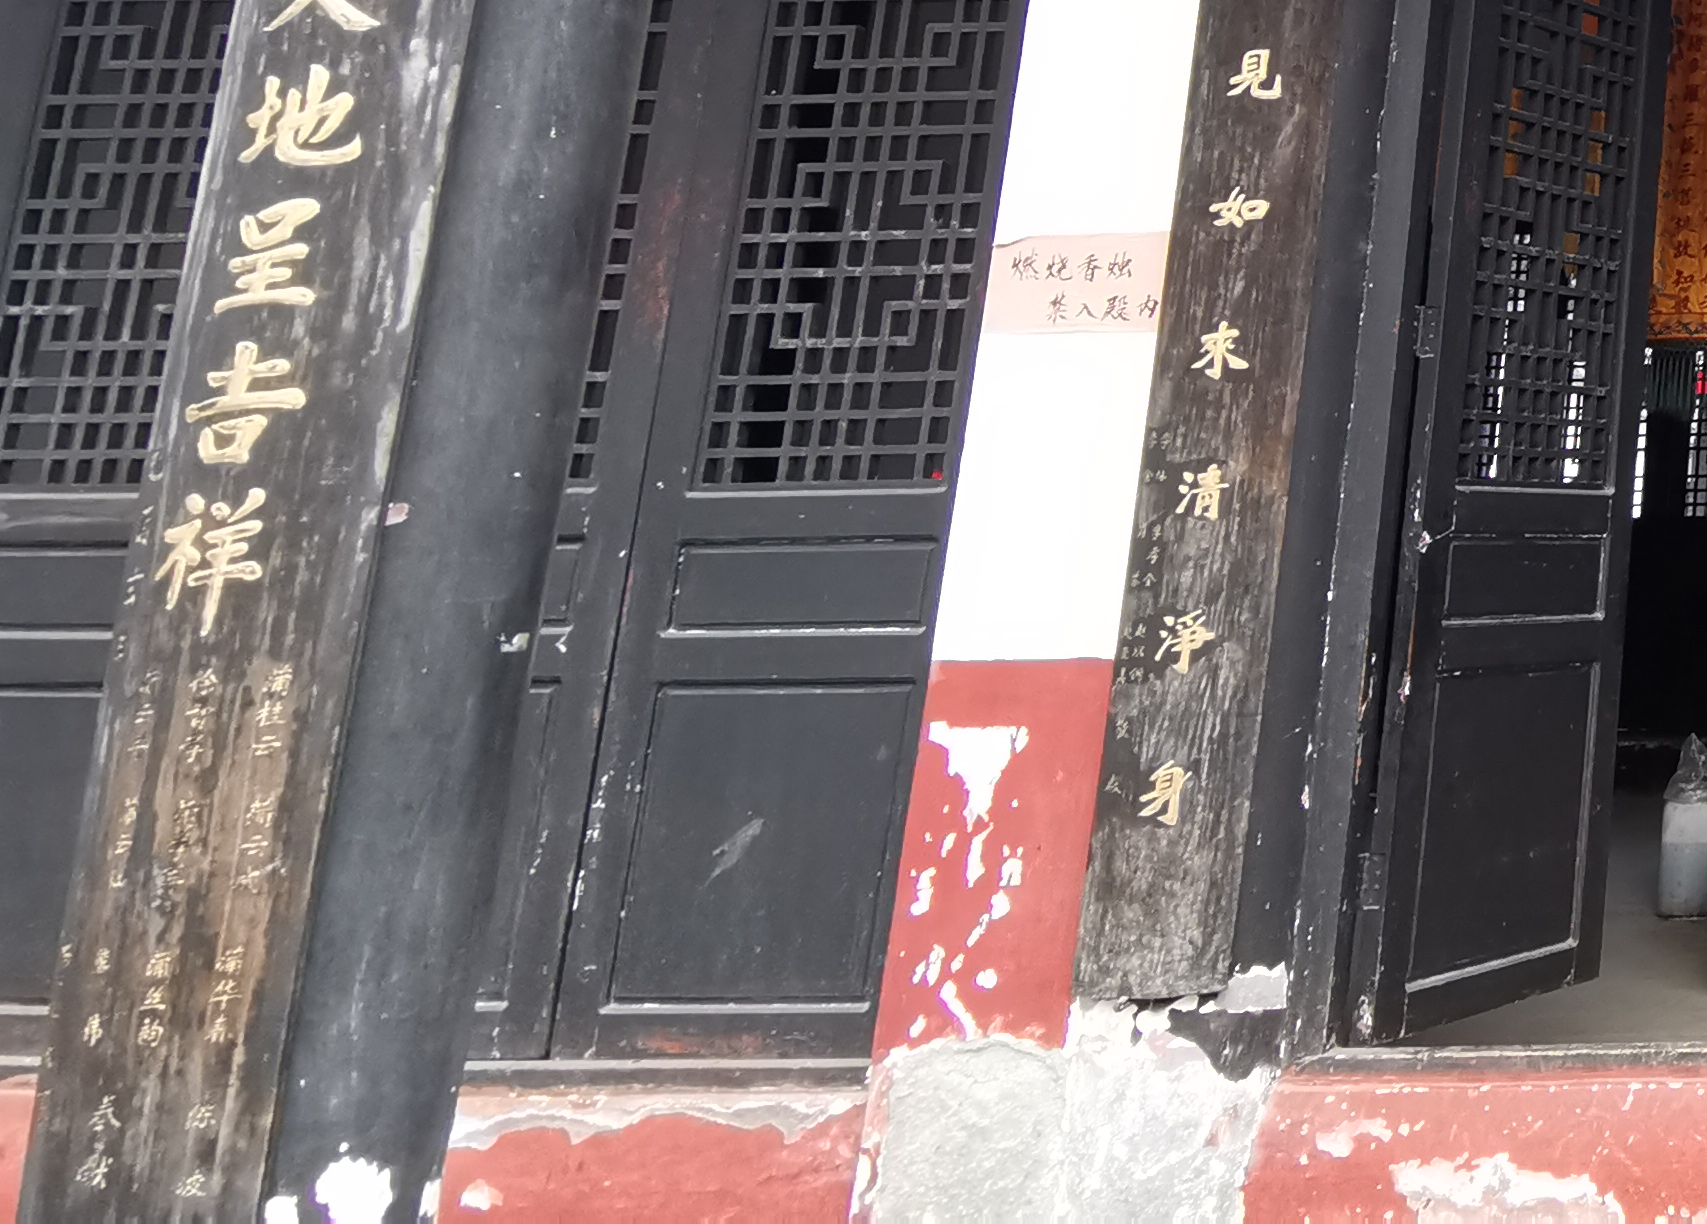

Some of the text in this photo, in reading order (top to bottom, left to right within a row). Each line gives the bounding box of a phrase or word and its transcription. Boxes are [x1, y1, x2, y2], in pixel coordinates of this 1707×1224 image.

[1011, 248, 1133, 282] 燃烧香烛
[1046, 291, 1160, 325] 禁入殿内
